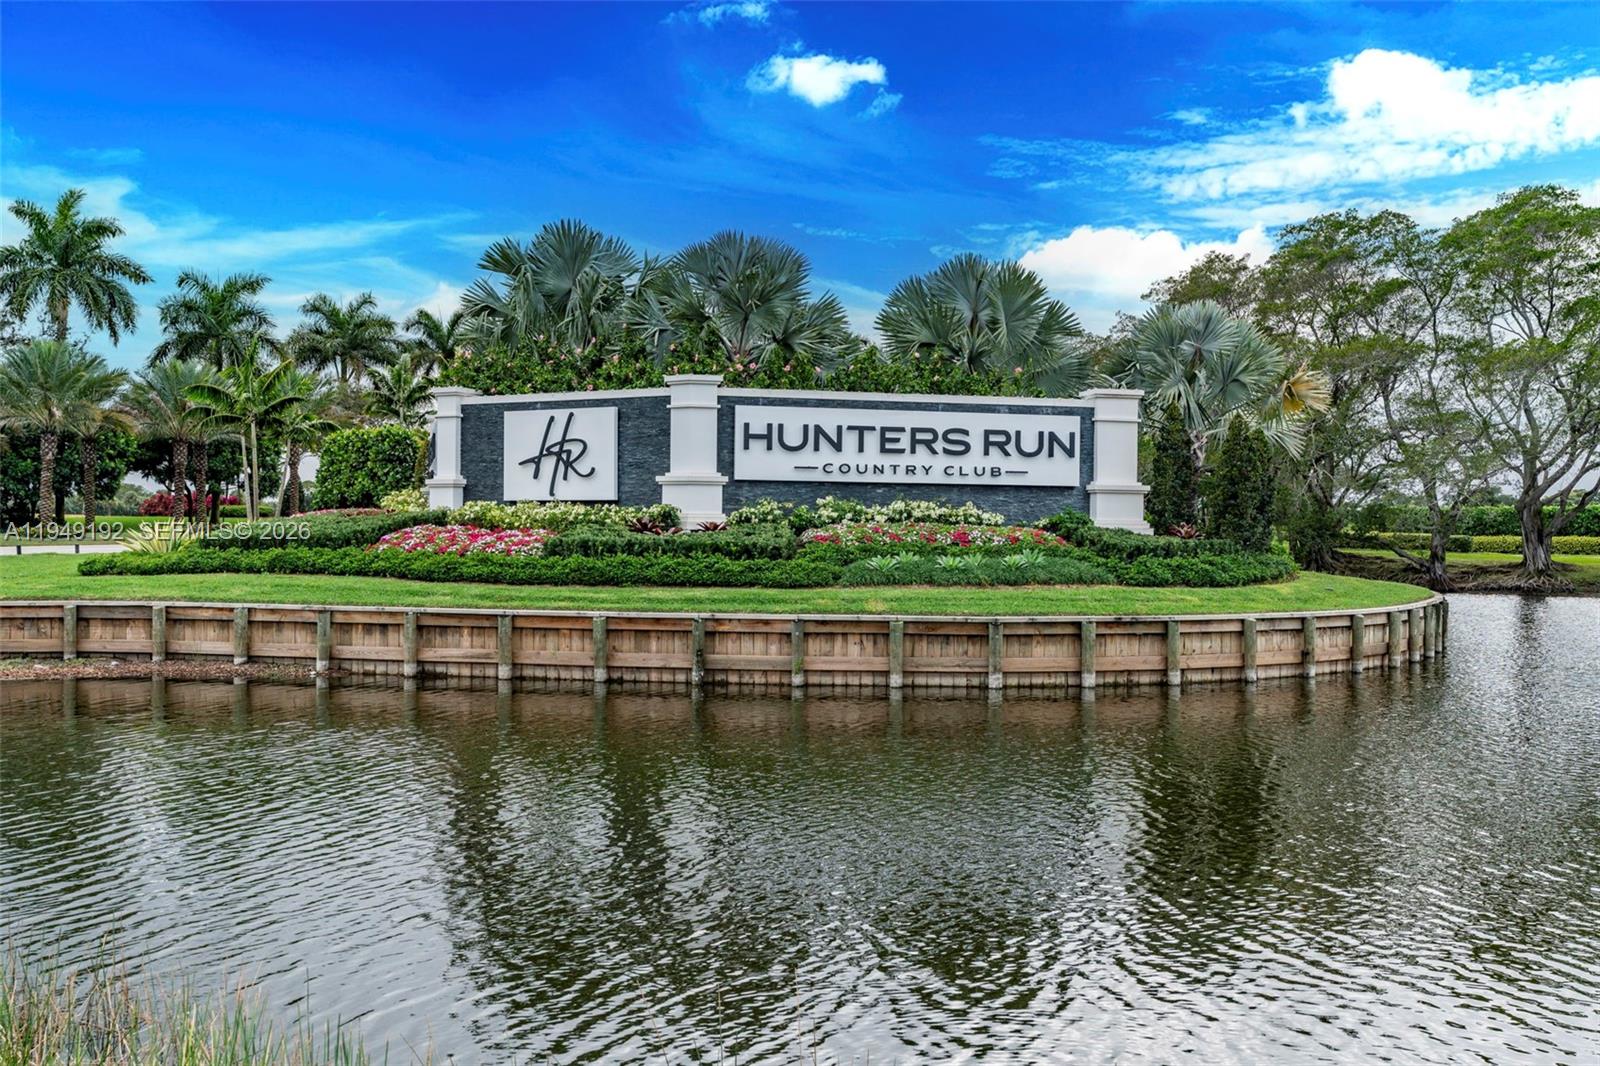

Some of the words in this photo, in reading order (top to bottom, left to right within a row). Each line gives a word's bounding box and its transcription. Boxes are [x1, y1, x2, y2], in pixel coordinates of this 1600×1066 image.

[743, 422, 972, 456] HUNTERS
[983, 429, 1076, 458] RUN
[822, 463, 933, 477] COUNTRY
[944, 465, 1002, 477] CLUB
